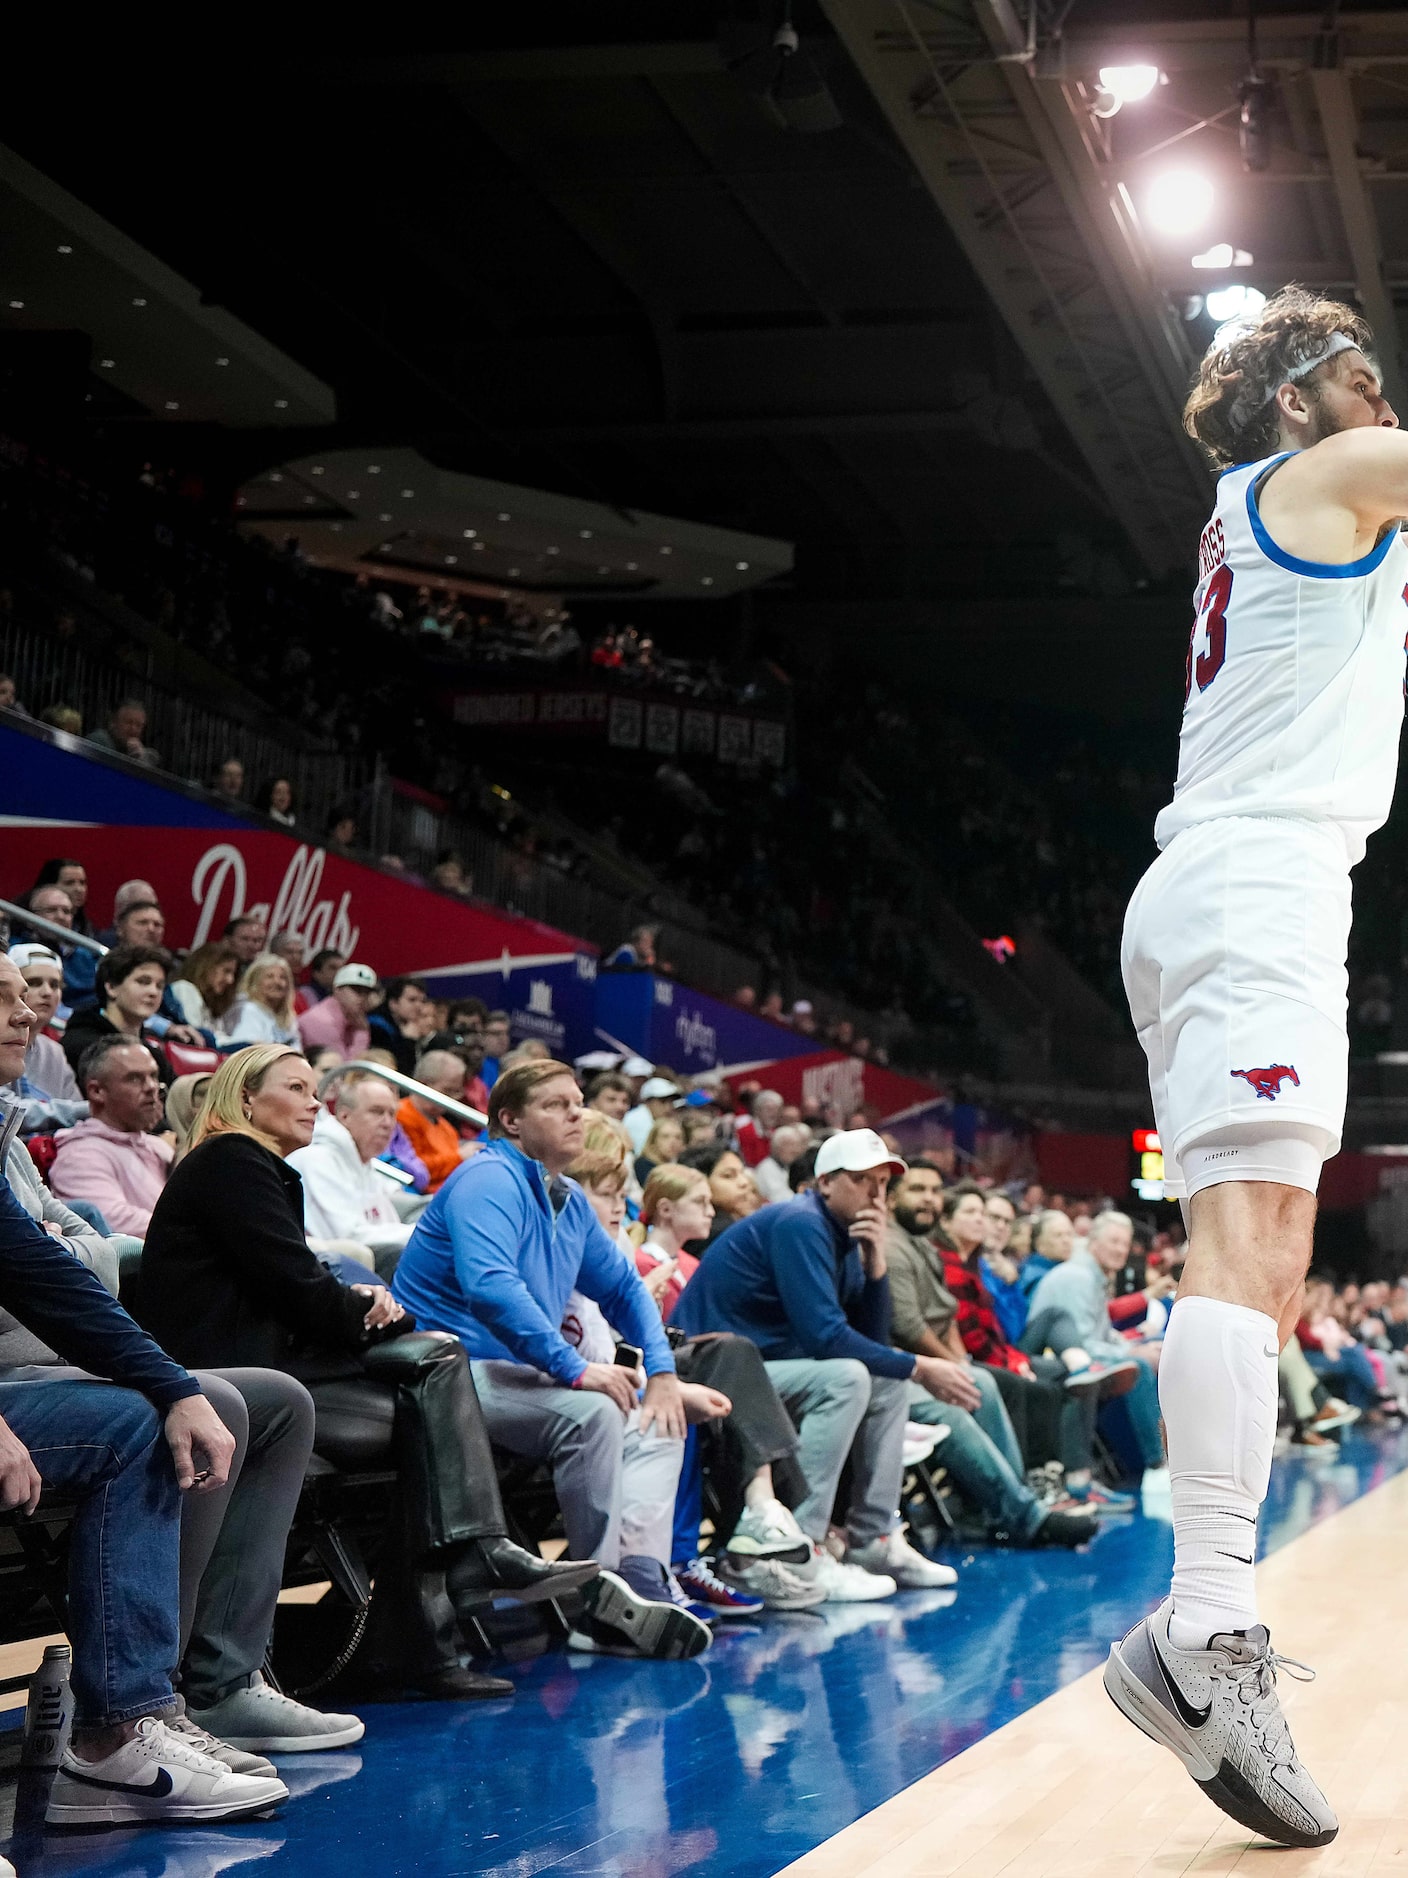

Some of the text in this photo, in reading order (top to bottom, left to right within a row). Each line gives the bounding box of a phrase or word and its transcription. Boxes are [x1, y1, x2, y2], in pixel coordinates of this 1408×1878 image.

[1198, 517, 1226, 582] ROSS
[1183, 561, 1235, 714] 3
[187, 842, 360, 968] Dallas
[33, 1686, 66, 1731] Lite
